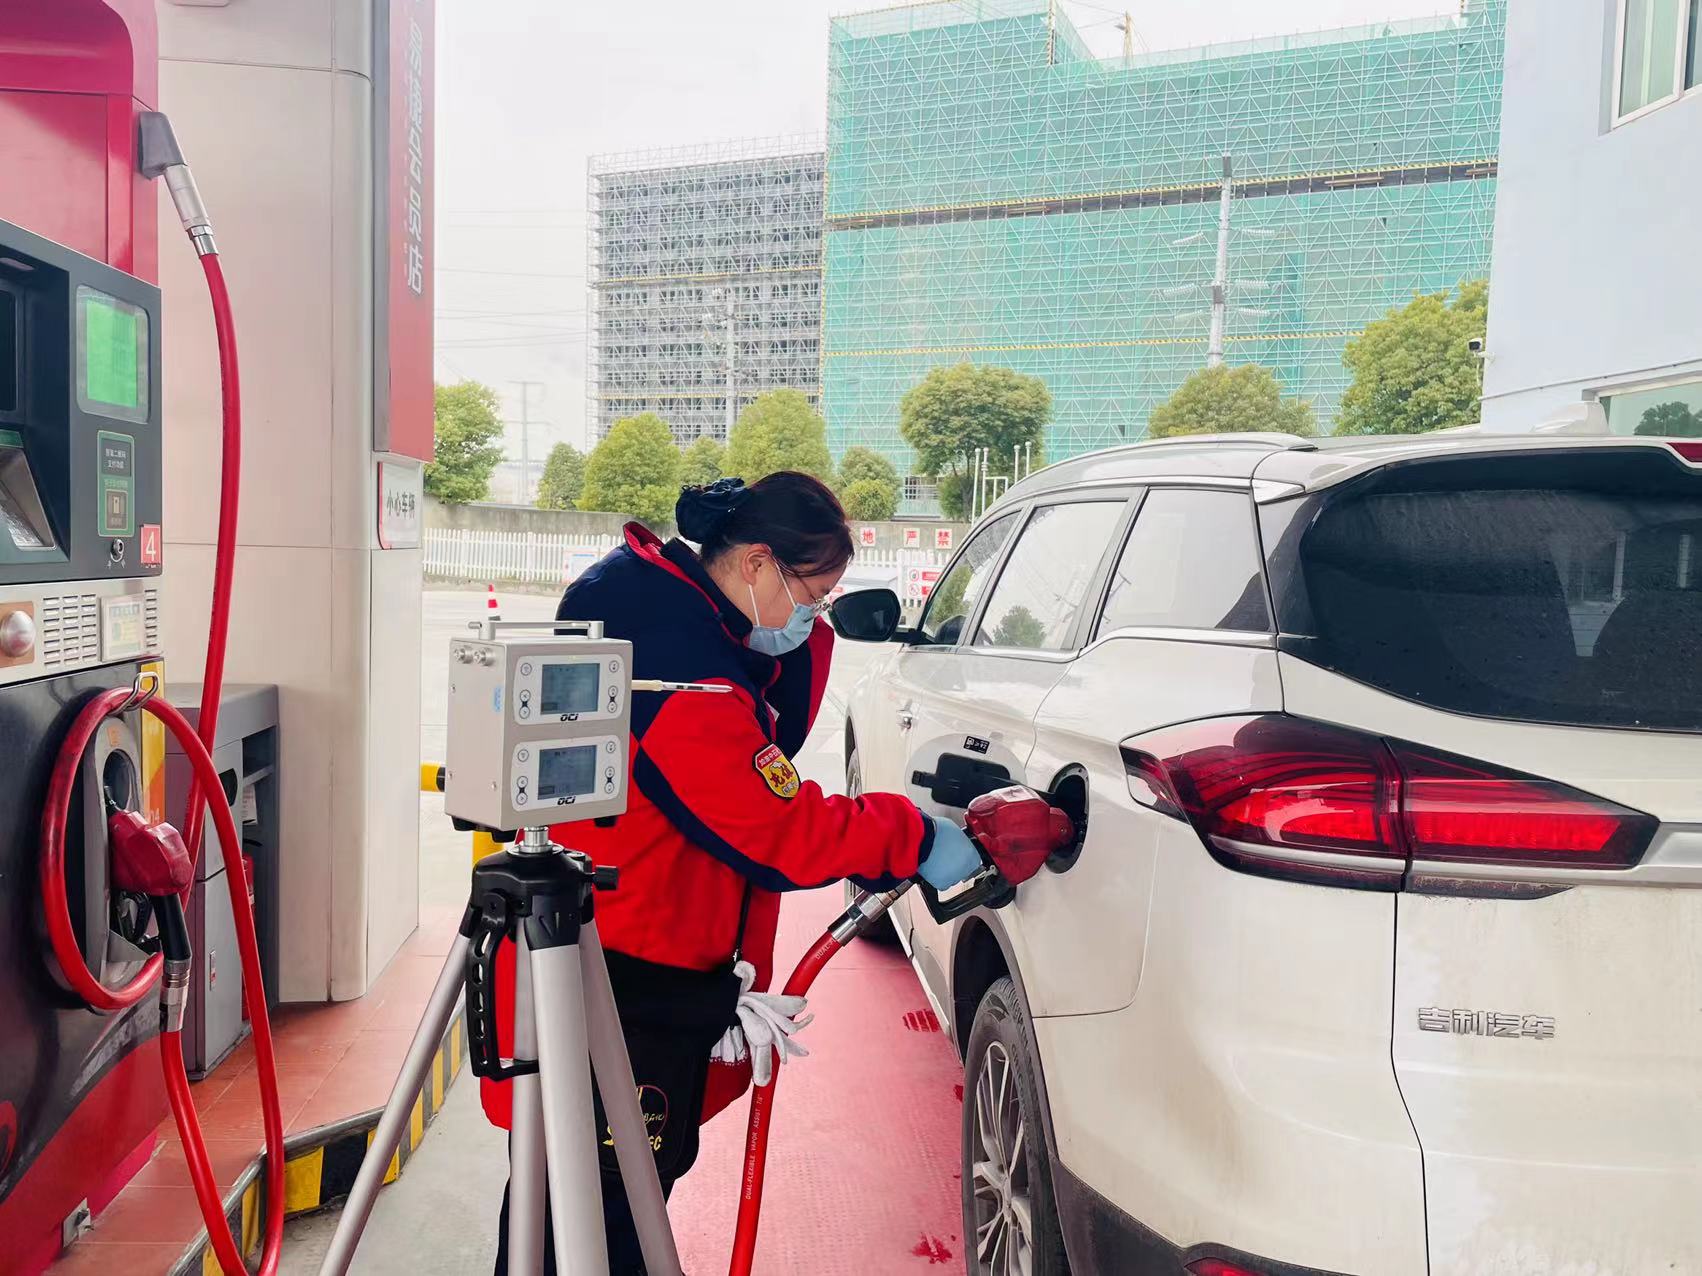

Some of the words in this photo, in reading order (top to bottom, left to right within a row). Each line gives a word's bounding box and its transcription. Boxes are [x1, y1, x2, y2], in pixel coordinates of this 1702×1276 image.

[145, 531, 156, 562] 4
[1418, 1007, 1556, 1040] 吉利汽车
[753, 1108, 761, 1128] ASSIST
[750, 1131, 759, 1151] VAPOR
[745, 1154, 756, 1200] DUAL-FLEXIBLE
